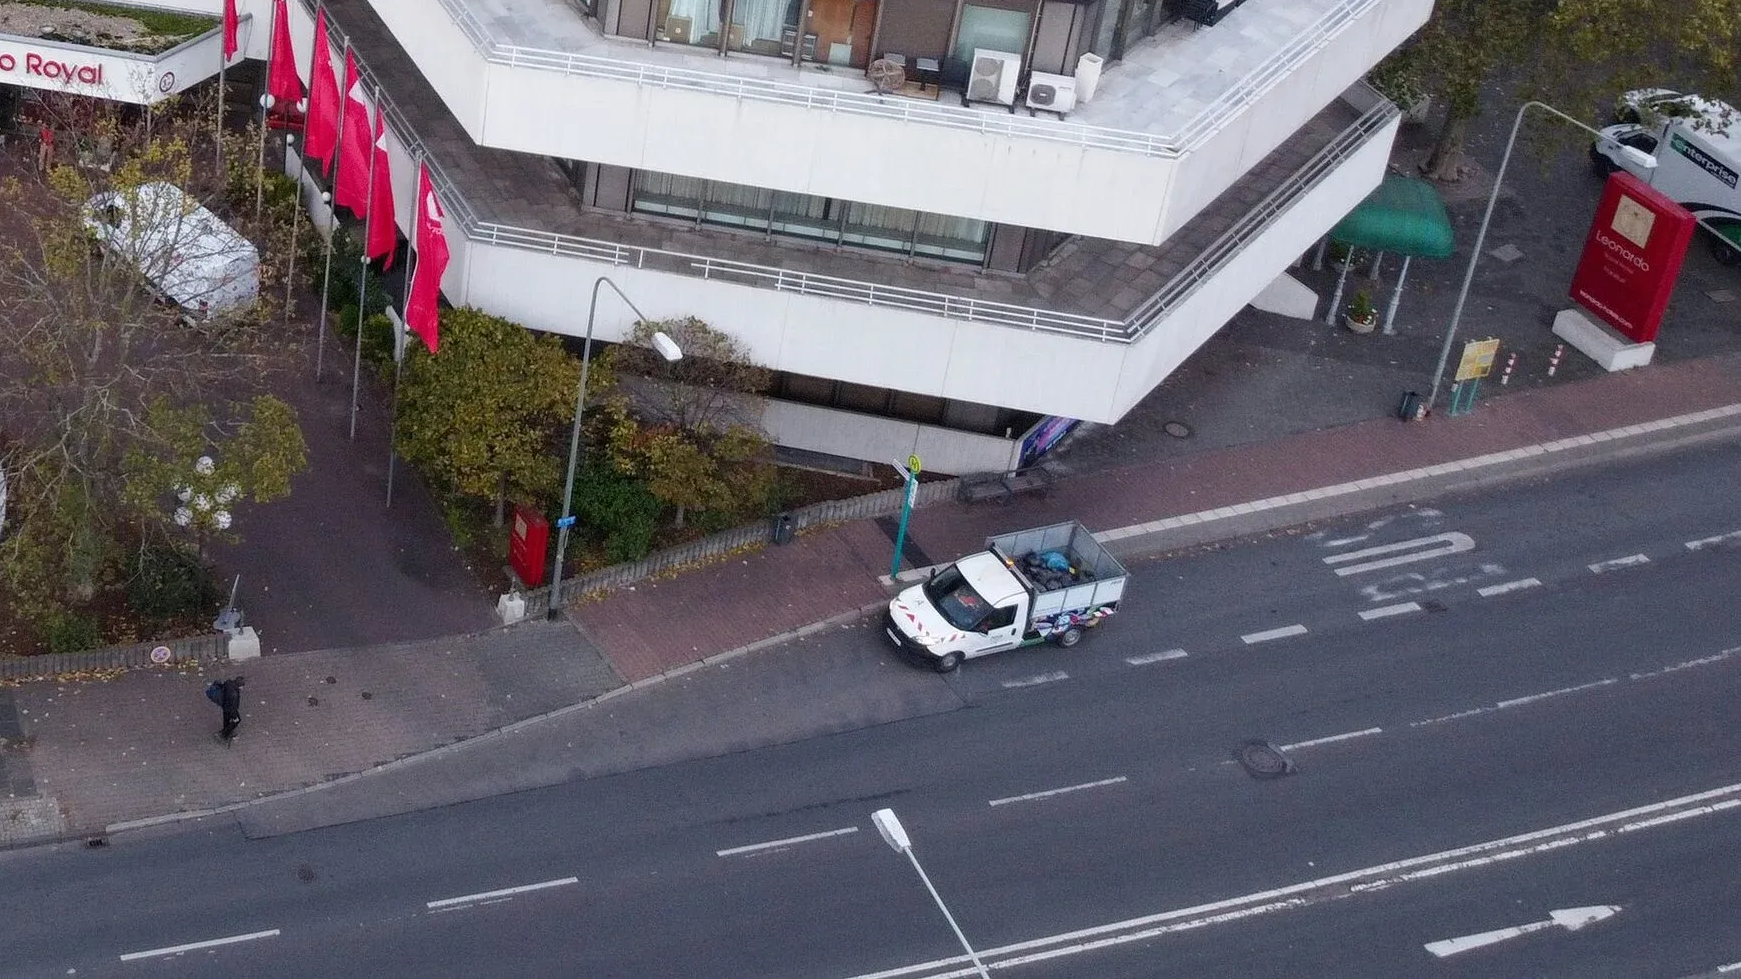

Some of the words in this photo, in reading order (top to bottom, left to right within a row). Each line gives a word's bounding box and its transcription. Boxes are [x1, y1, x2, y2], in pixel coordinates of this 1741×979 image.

[26, 52, 103, 85] Royal
[1674, 139, 1736, 184] enterprise
[1595, 229, 1650, 272] Leonardo
